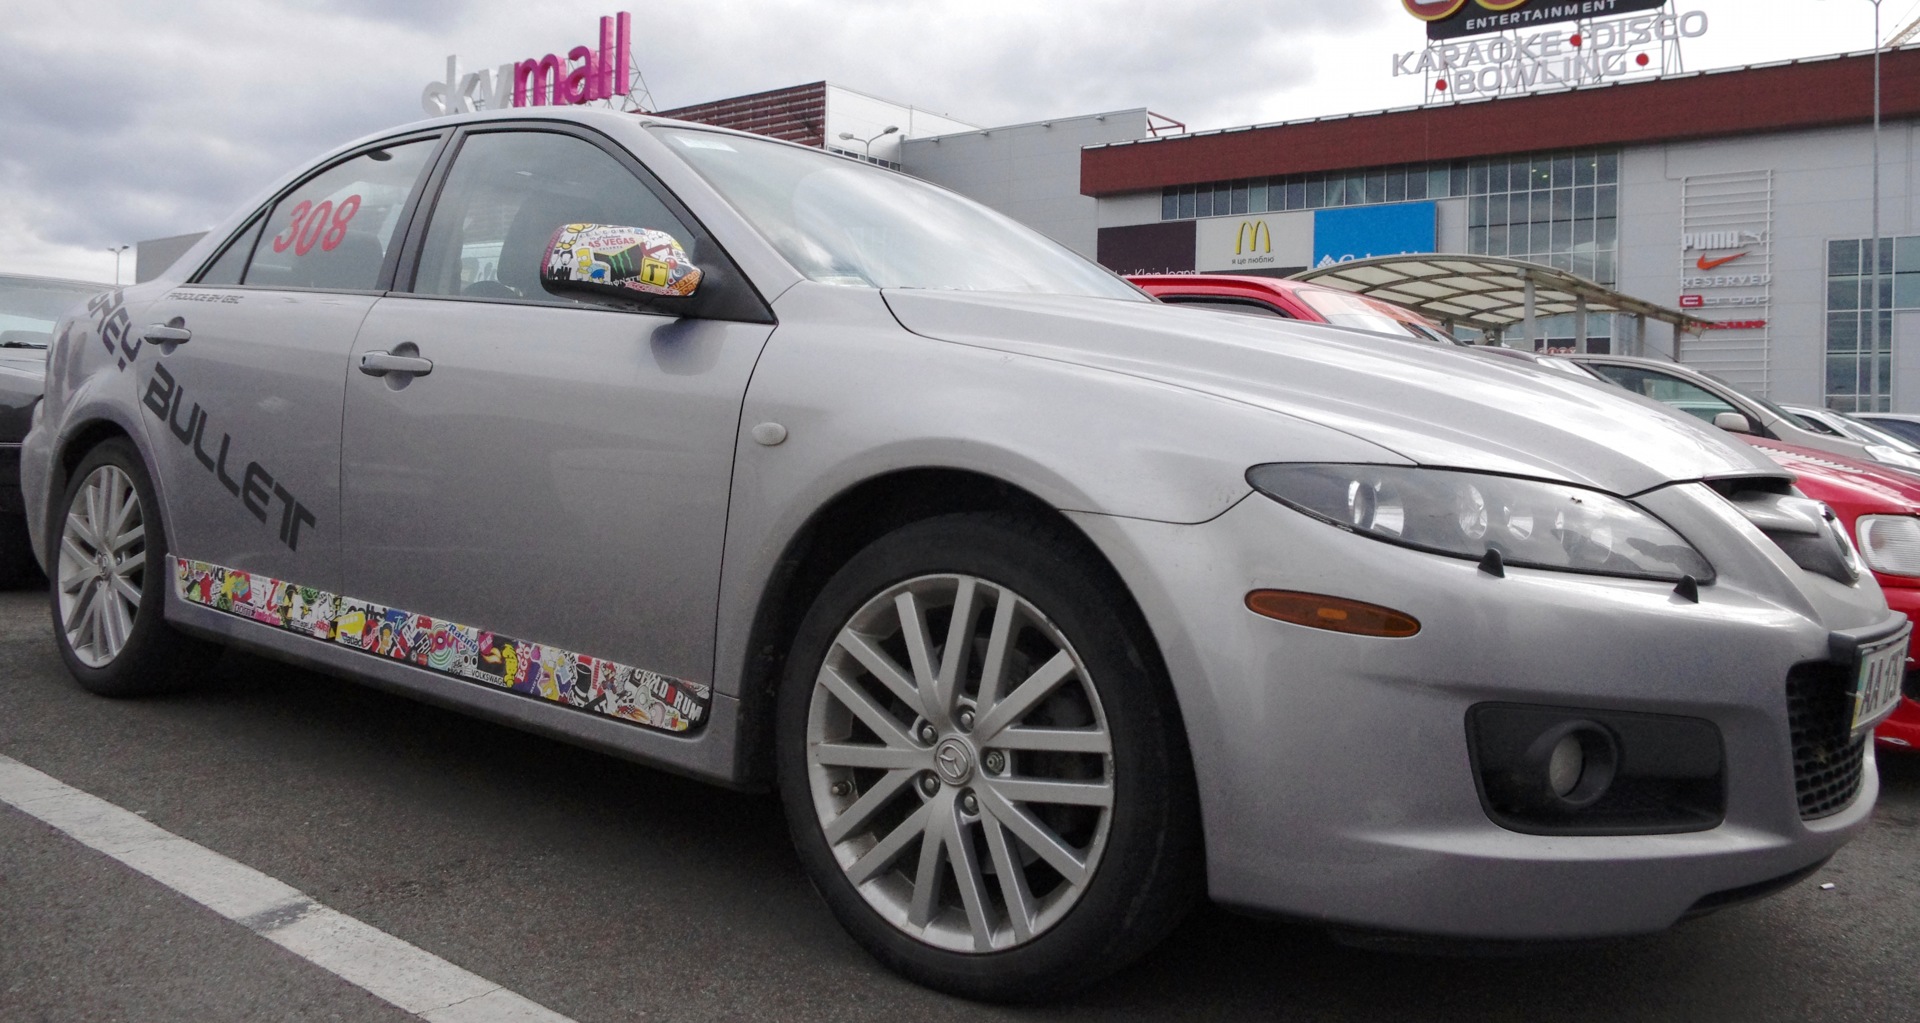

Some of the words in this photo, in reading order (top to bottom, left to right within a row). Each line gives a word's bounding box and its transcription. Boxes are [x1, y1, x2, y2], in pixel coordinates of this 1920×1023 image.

[1465, 0, 1617, 31] ENTERTAINMENT
[1391, 29, 1563, 78] KARAOKE
[1590, 9, 1709, 50] DISCO
[1453, 49, 1628, 96] BOWLING
[272, 194, 362, 257] 308
[1682, 230, 1740, 251] PUMA
[602, 236, 637, 247] VEGAS
[1682, 273, 1771, 288] RESERVED
[447, 622, 479, 654] Racing
